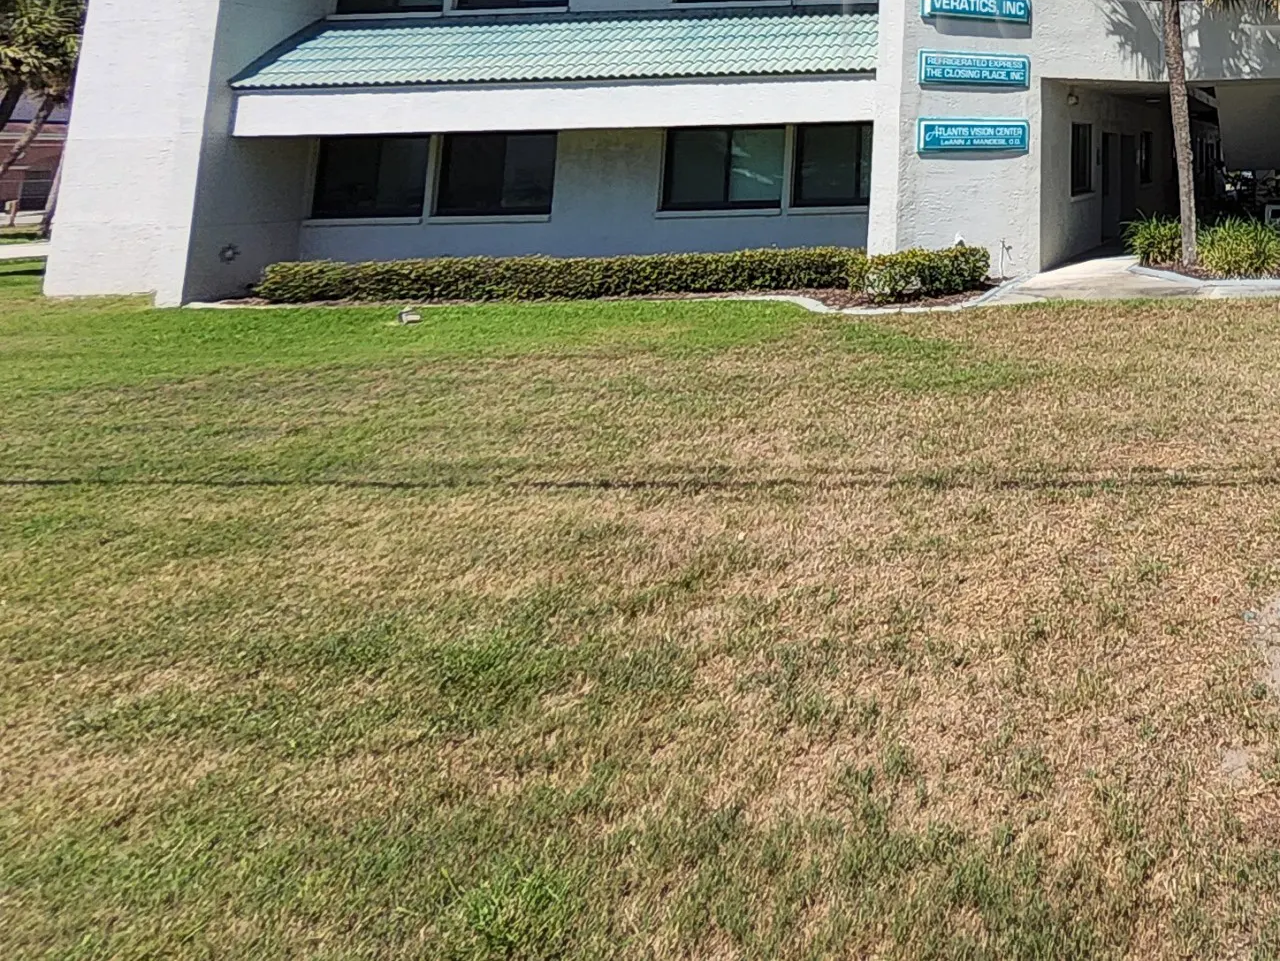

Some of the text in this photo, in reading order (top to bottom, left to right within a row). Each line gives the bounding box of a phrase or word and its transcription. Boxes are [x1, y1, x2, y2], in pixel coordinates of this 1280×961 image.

[1002, 0, 1025, 16] INC
[927, 56, 1023, 69] REFRIGERATED EXPRESS
[926, 68, 943, 78] THE
[944, 68, 980, 79] CLOSING
[1009, 71, 1025, 81] INC
[925, 126, 1023, 141] ATLANTIS VISION CENTER
